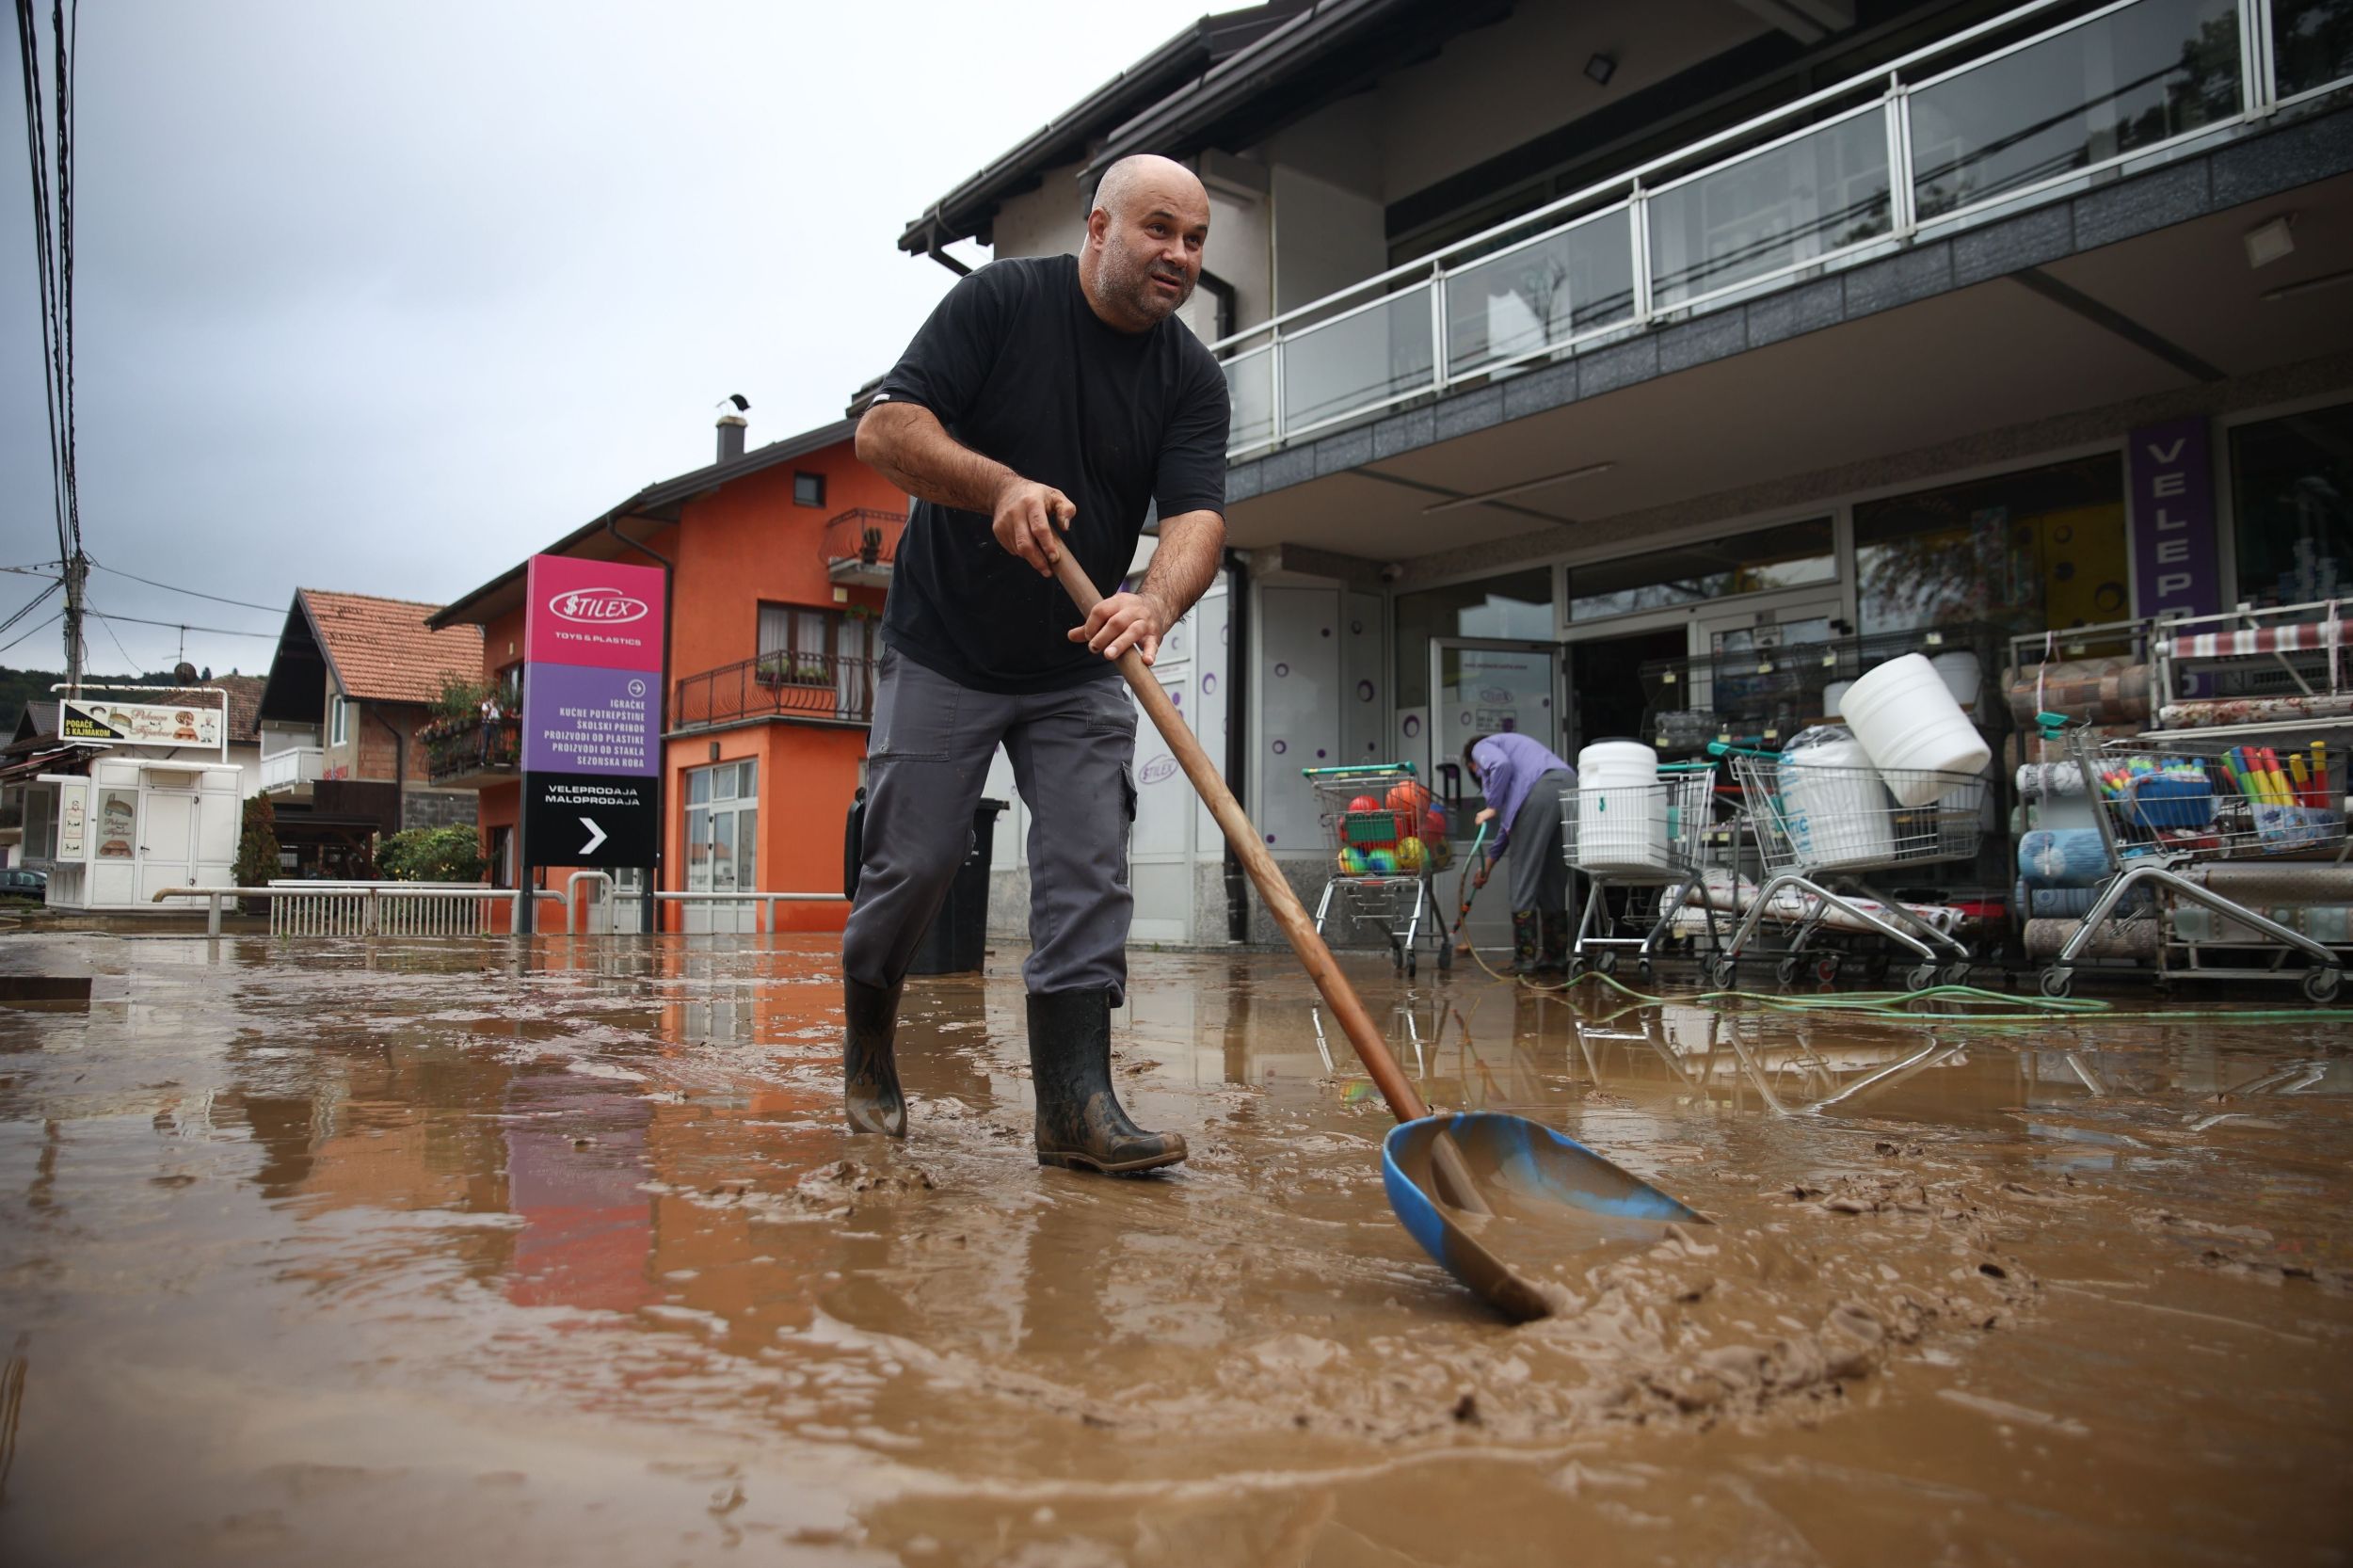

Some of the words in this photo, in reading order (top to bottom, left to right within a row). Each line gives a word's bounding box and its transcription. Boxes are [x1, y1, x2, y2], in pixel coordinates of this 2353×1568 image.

[555, 632, 583, 641] TOYS
[593, 634, 642, 647] PLASTICS
[610, 698, 646, 711] IGRAČKE
[589, 709, 645, 722] POTREPŠTINE
[65, 719, 93, 728] POGAČE
[576, 719, 613, 731] ŠKOLSKI
[614, 723, 646, 733] PRIBOR
[72, 728, 111, 738] KAJMAKOM
[544, 729, 590, 742] PROIZVODI
[592, 733, 603, 743] OD
[605, 733, 645, 744] PLASTIKE
[552, 743, 598, 754] PROIZVODI
[600, 744, 612, 755] OD
[614, 745, 645, 757] STAKLA
[576, 756, 620, 767] SEZONSKA
[621, 757, 645, 768] ROBA
[548, 784, 638, 796] VELEPRODAJA
[545, 794, 640, 807] MALOPRODAJA
